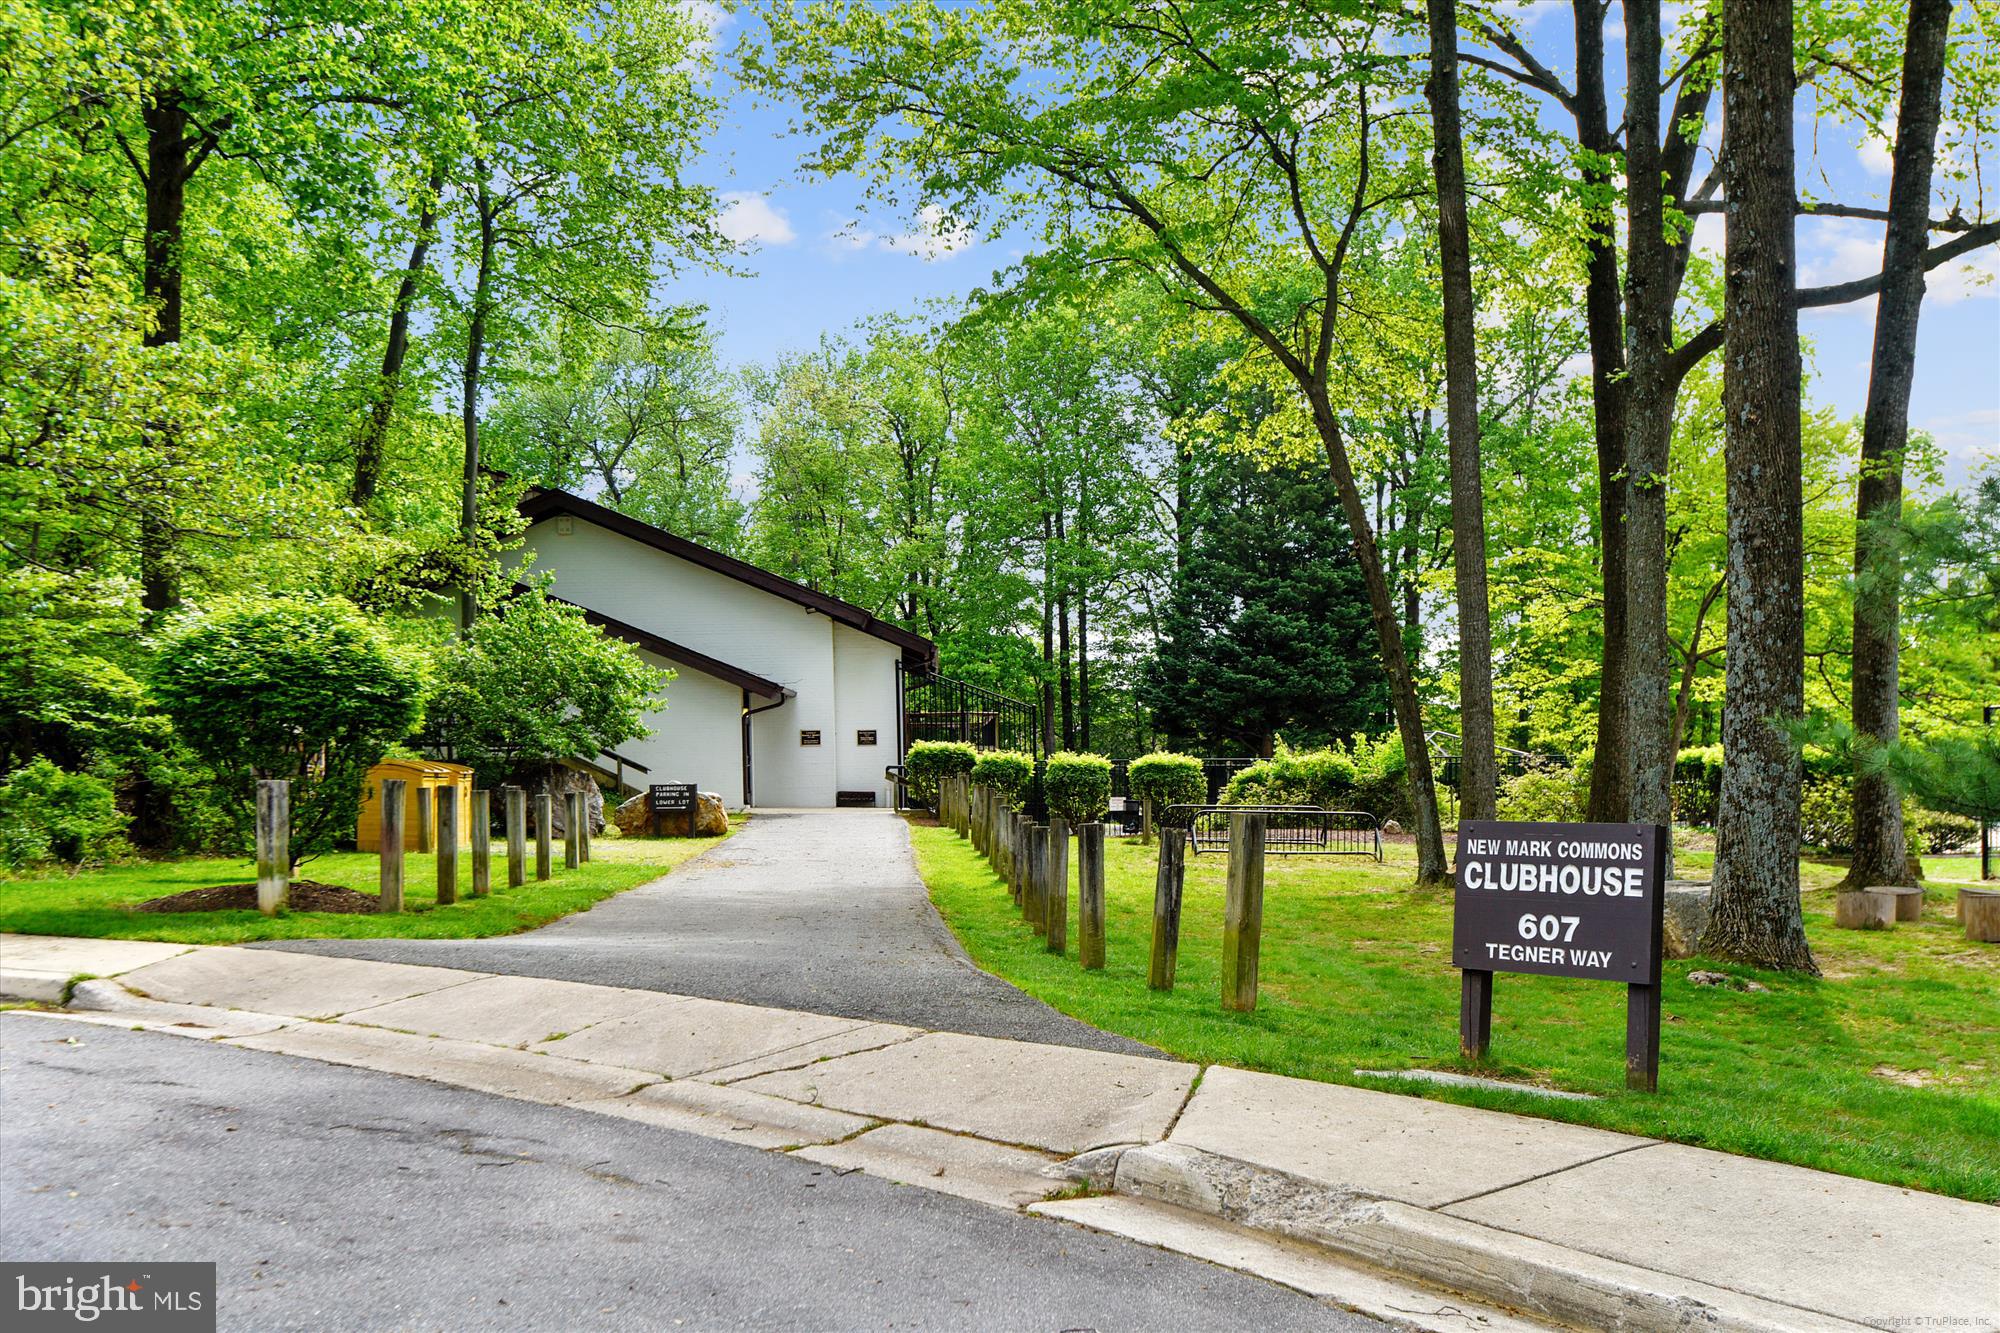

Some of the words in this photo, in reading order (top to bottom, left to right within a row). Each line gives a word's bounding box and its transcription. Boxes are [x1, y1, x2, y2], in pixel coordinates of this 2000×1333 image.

[1467, 839, 1501, 855] NEW
[1506, 840, 1552, 857] MARK
[1557, 841, 1643, 860] COMMONS
[1464, 861, 1644, 898] CLUBHOUSE
[1518, 913, 1581, 943] 607
[1485, 943, 1565, 965] TEGNER
[1570, 949, 1613, 968] WAY
